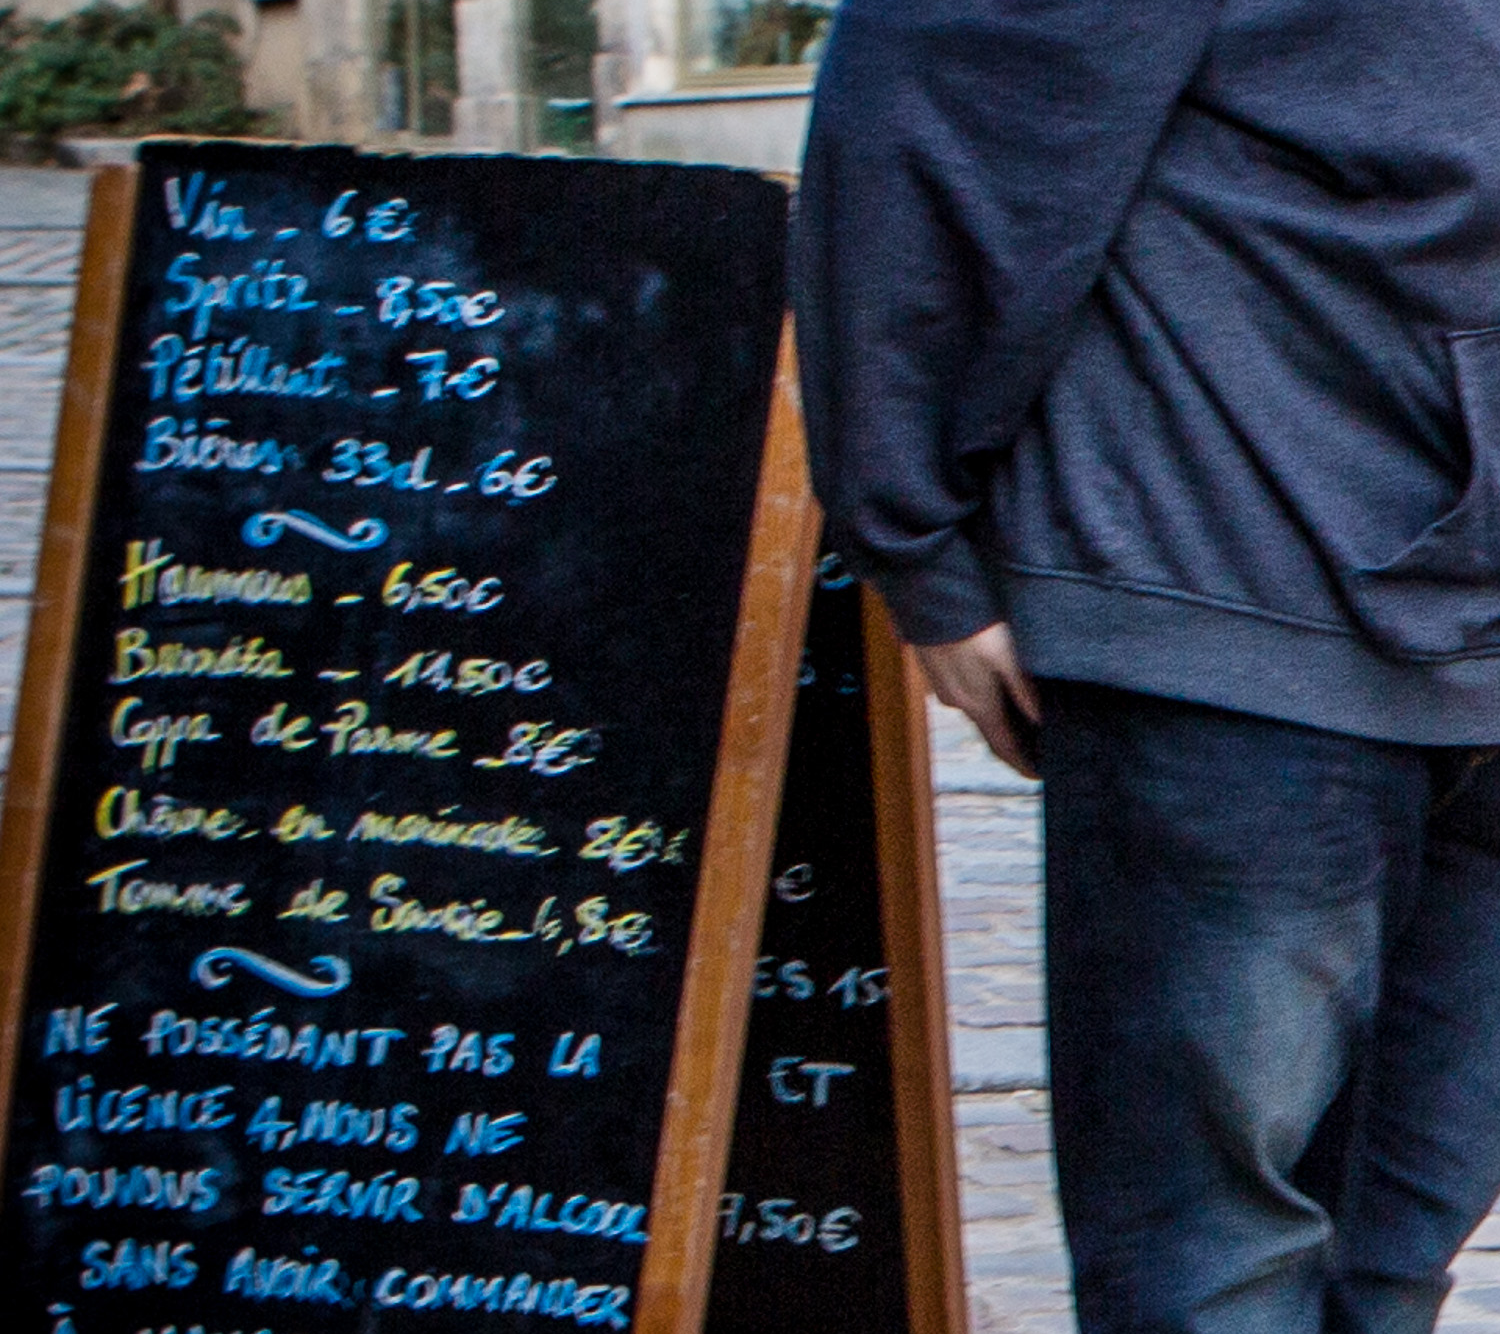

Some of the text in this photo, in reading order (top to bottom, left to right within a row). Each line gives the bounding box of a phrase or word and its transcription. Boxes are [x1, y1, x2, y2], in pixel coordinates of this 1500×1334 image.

[164, 171, 257, 241] Vin
[164, 251, 318, 340] Spritz
[375, 275, 505, 329] 8,50€
[139, 333, 348, 403] Pétillant
[403, 349, 500, 403] 7€
[478, 448, 559, 499] 6€
[381, 561, 506, 614] 6,50€
[110, 696, 223, 774] Coppa
[250, 702, 318, 753] de
[320, 700, 460, 758] Parme
[269, 804, 337, 843] en
[85, 858, 252, 917] Tomme
[275, 878, 350, 923] de
[370, 872, 512, 943] Savoie
[43, 1002, 601, 1079] NE POSSÉDANT PAS LA
[766, 1055, 857, 1107] ET
[443, 1111, 528, 1157] NE
[21, 1163, 651, 1245] POUVONS SERVIR D'ALCOOL
[80, 1237, 632, 1331] SANS AVOIR COMMANDER
